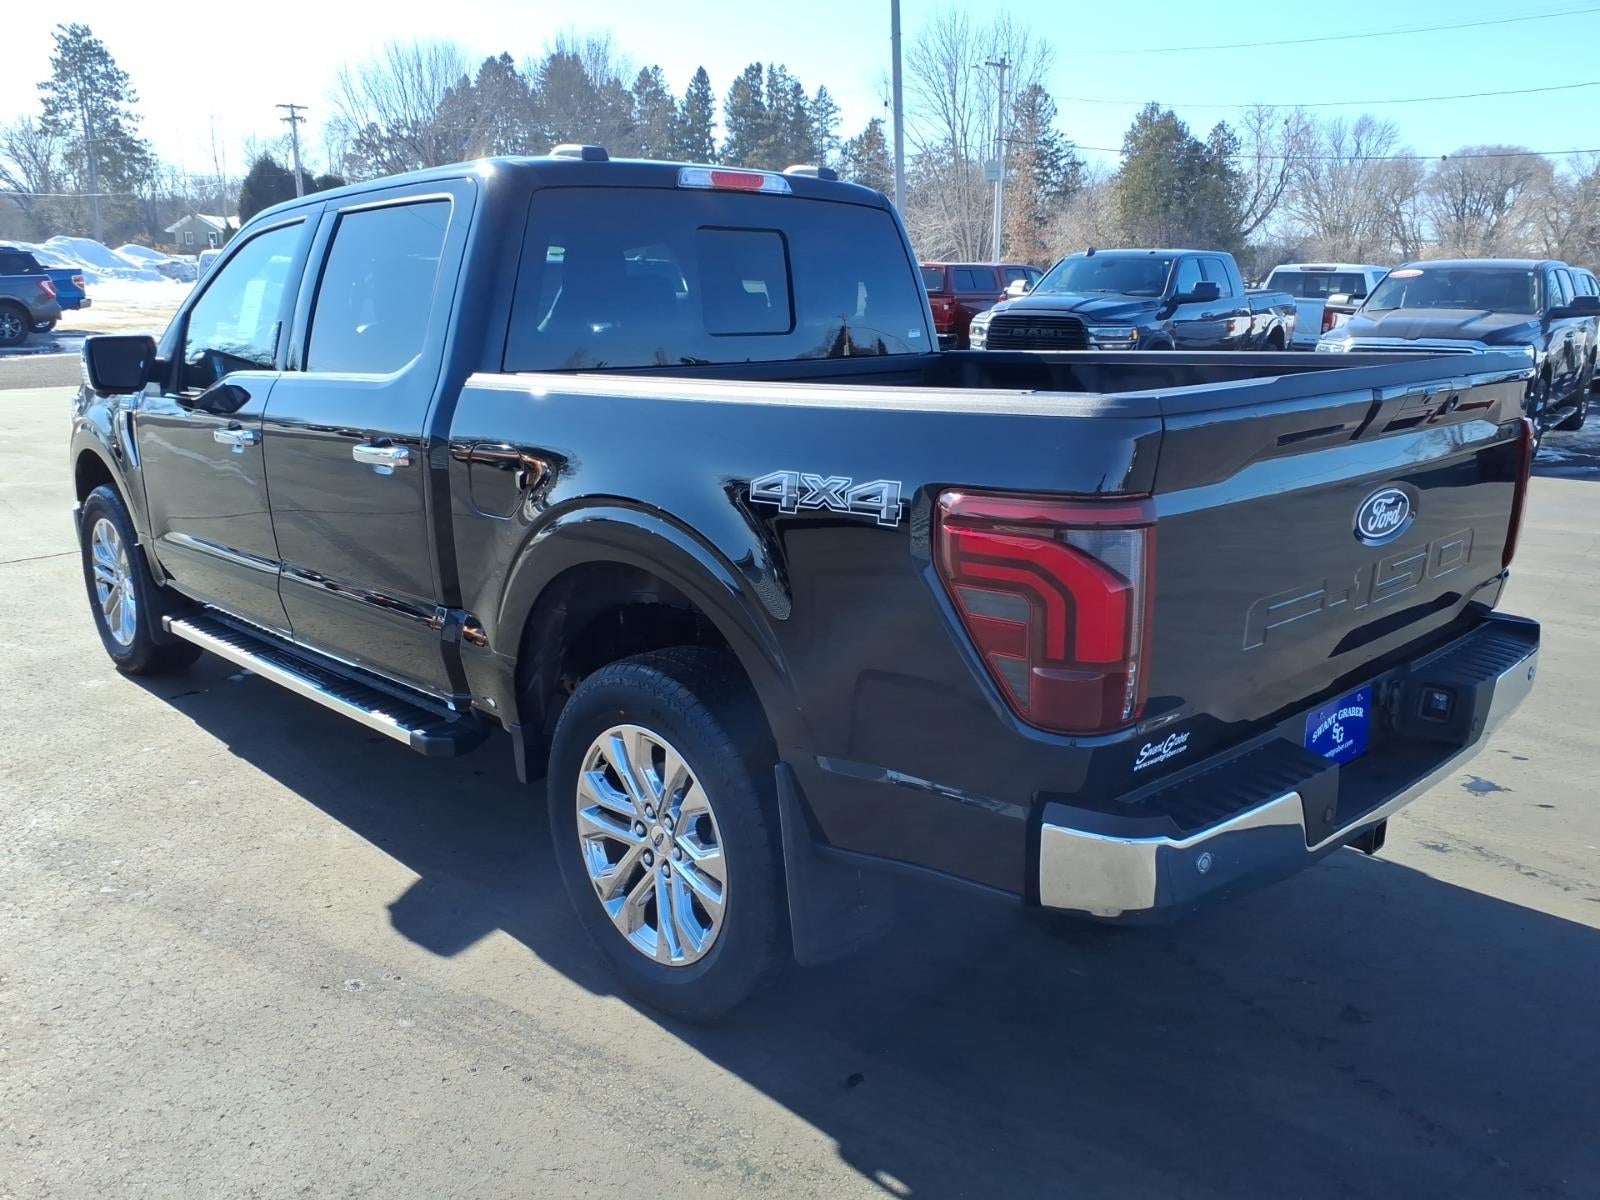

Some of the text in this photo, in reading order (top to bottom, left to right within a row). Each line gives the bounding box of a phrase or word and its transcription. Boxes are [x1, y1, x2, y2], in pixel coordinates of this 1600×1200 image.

[1010, 327, 1054, 337] RAM
[1368, 497, 1402, 531] Ford
[1243, 528, 1474, 651] F-150
[1312, 706, 1364, 743] SWANT GRABER
[1136, 732, 1190, 765] Swant Graber
